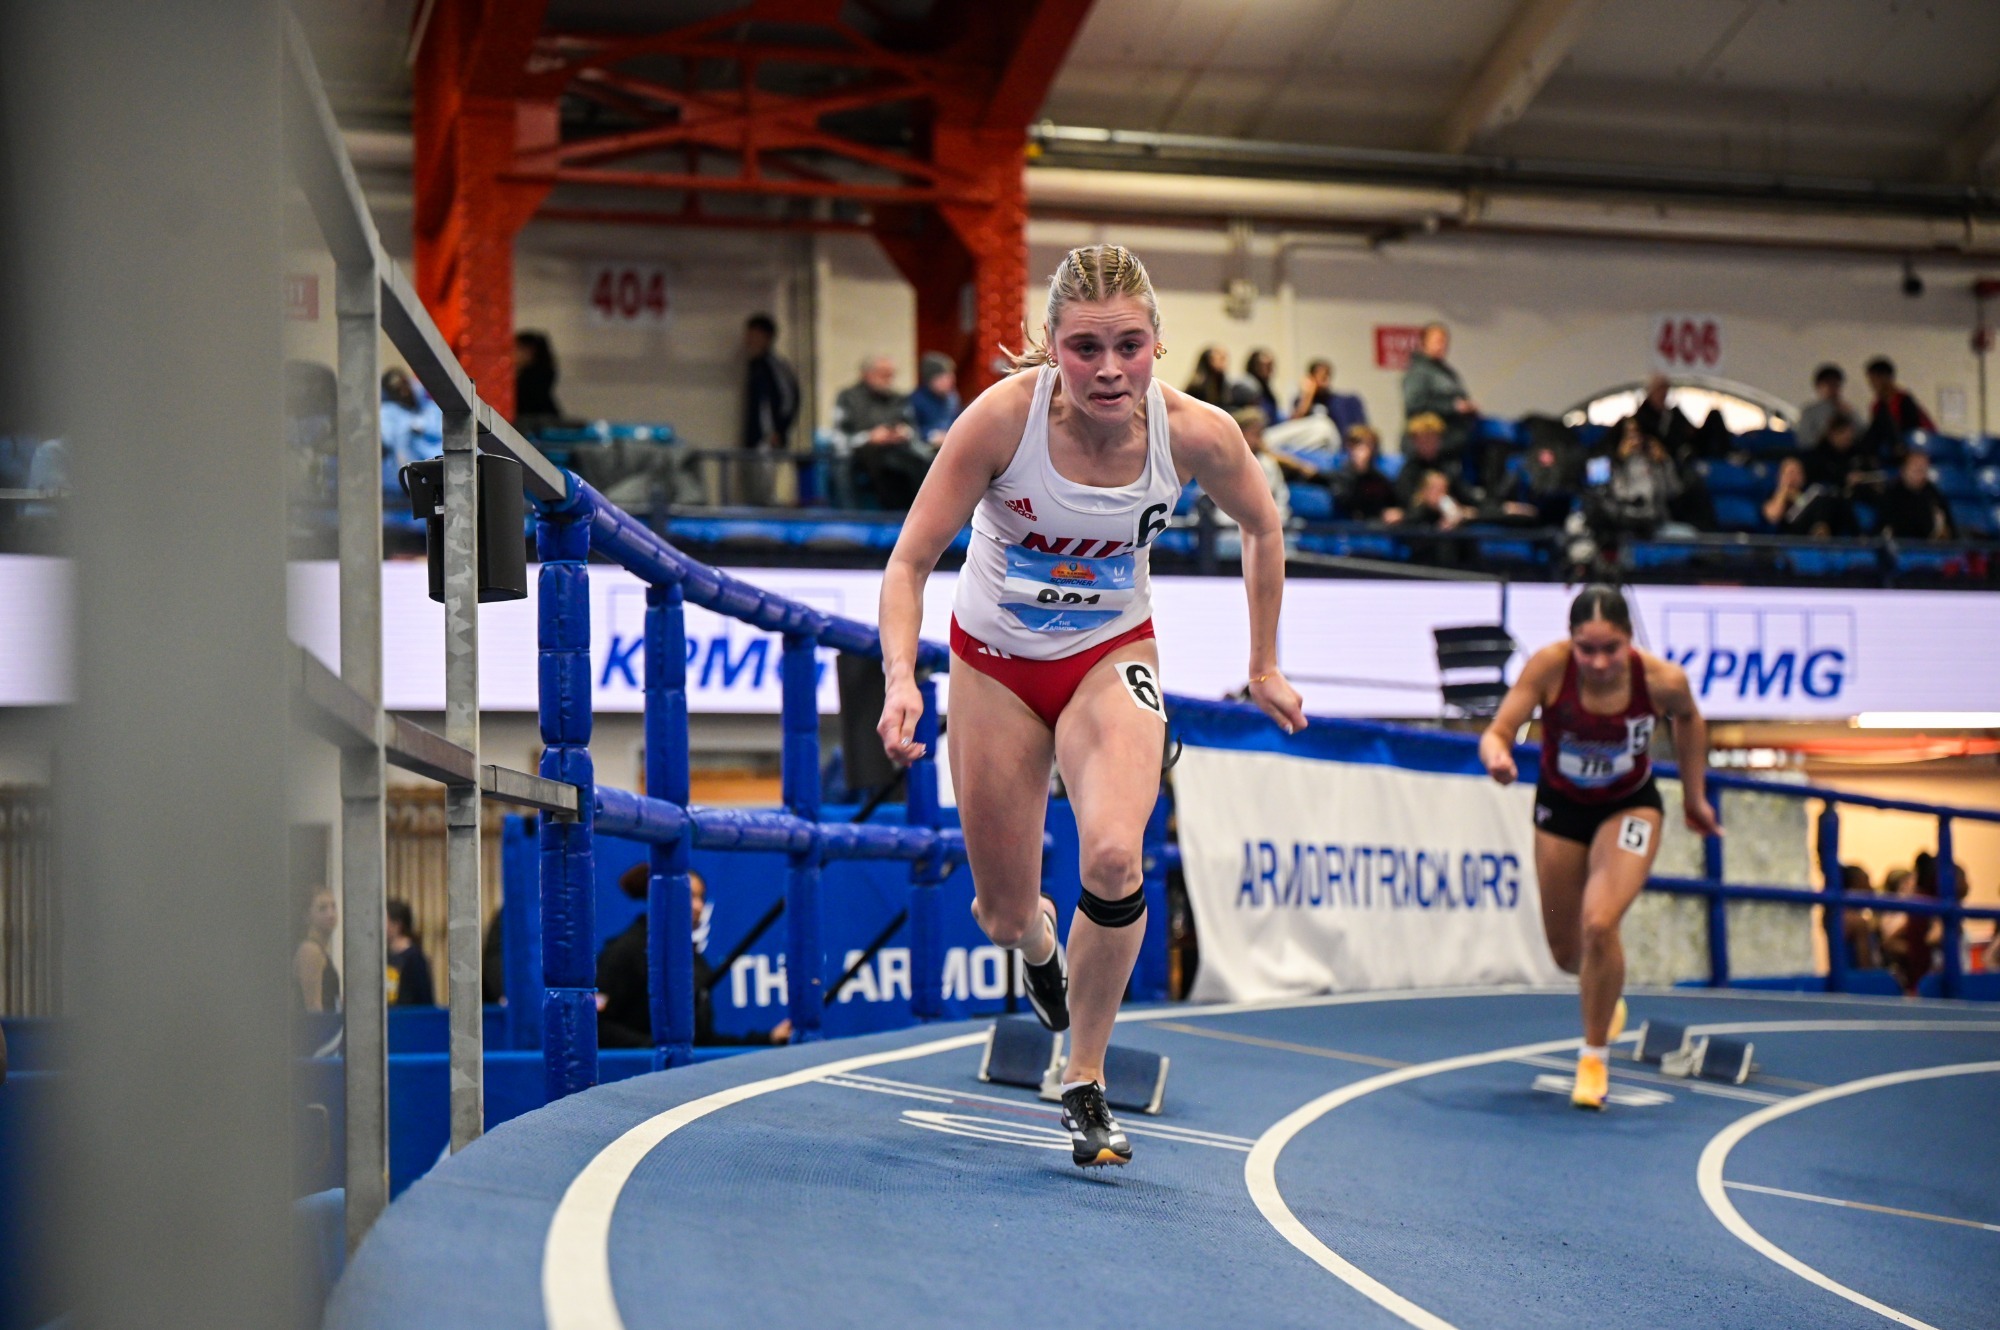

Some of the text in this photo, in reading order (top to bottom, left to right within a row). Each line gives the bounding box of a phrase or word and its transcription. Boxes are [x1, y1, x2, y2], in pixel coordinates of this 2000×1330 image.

[591, 271, 666, 318] 404
[1657, 319, 1720, 366] 406
[1004, 500, 1037, 521] adidas
[1136, 503, 1168, 548] 6
[600, 635, 827, 689] KM
[1665, 648, 1846, 698] PMG
[1125, 664, 1160, 712] 6
[1633, 722, 1651, 755] 5
[1624, 821, 1644, 850] 5
[730, 951, 791, 1009] TH
